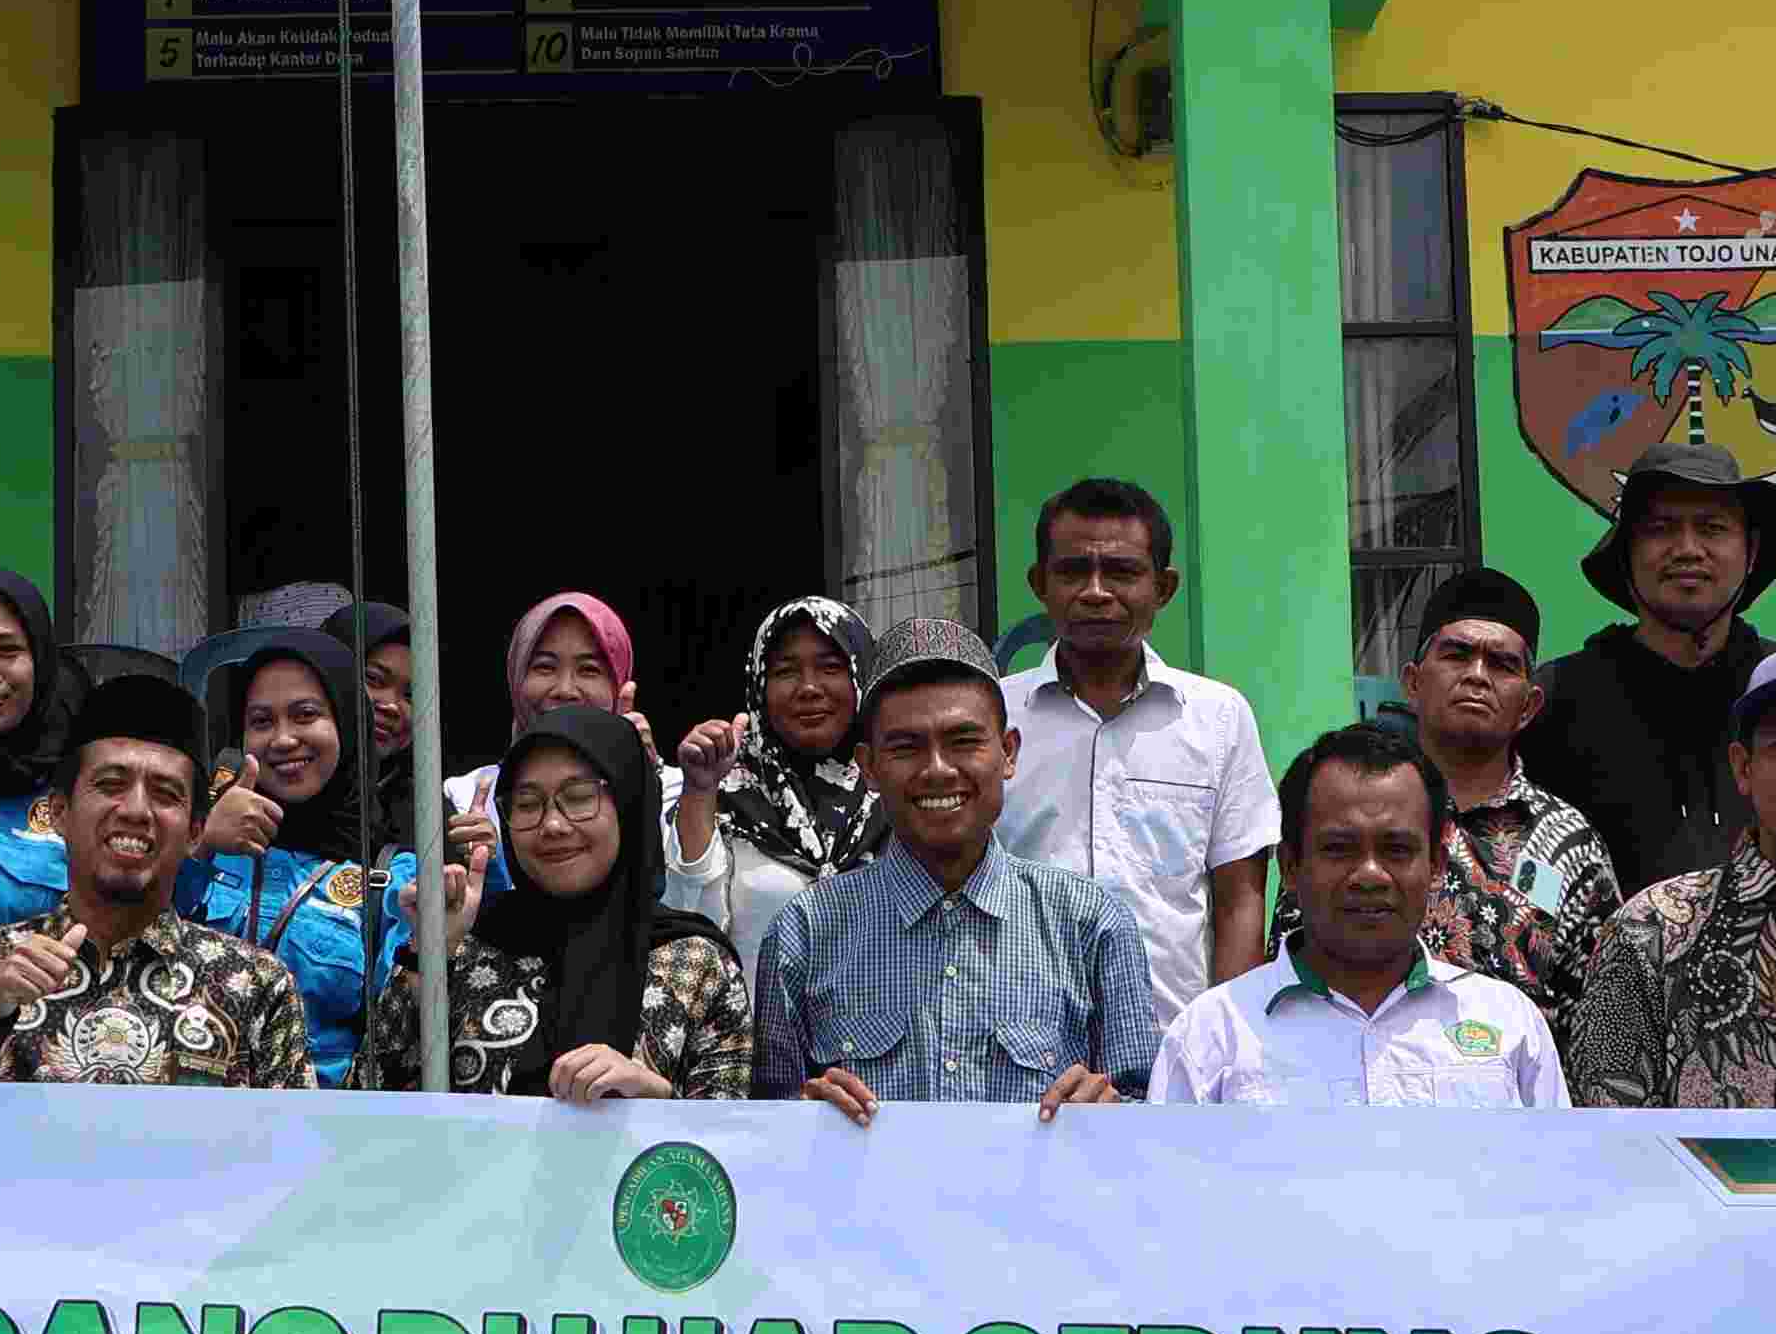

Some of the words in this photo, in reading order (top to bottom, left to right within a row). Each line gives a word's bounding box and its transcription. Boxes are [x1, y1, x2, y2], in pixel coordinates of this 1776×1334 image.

[158, 36, 182, 67] 5
[195, 30, 231, 45] Malu
[236, 29, 276, 44] Akan
[531, 32, 567, 64] 10
[580, 26, 617, 40] Malu
[619, 25, 662, 40] Tidak
[769, 22, 820, 39] Krama
[195, 52, 266, 71] Terhadap
[270, 51, 322, 66] Kantor
[581, 46, 612, 60] Dan
[614, 46, 663, 65] Sopan
[665, 45, 721, 60] Santun
[1538, 244, 1670, 266] KABUPATEN
[1676, 243, 1734, 264] TOJO
